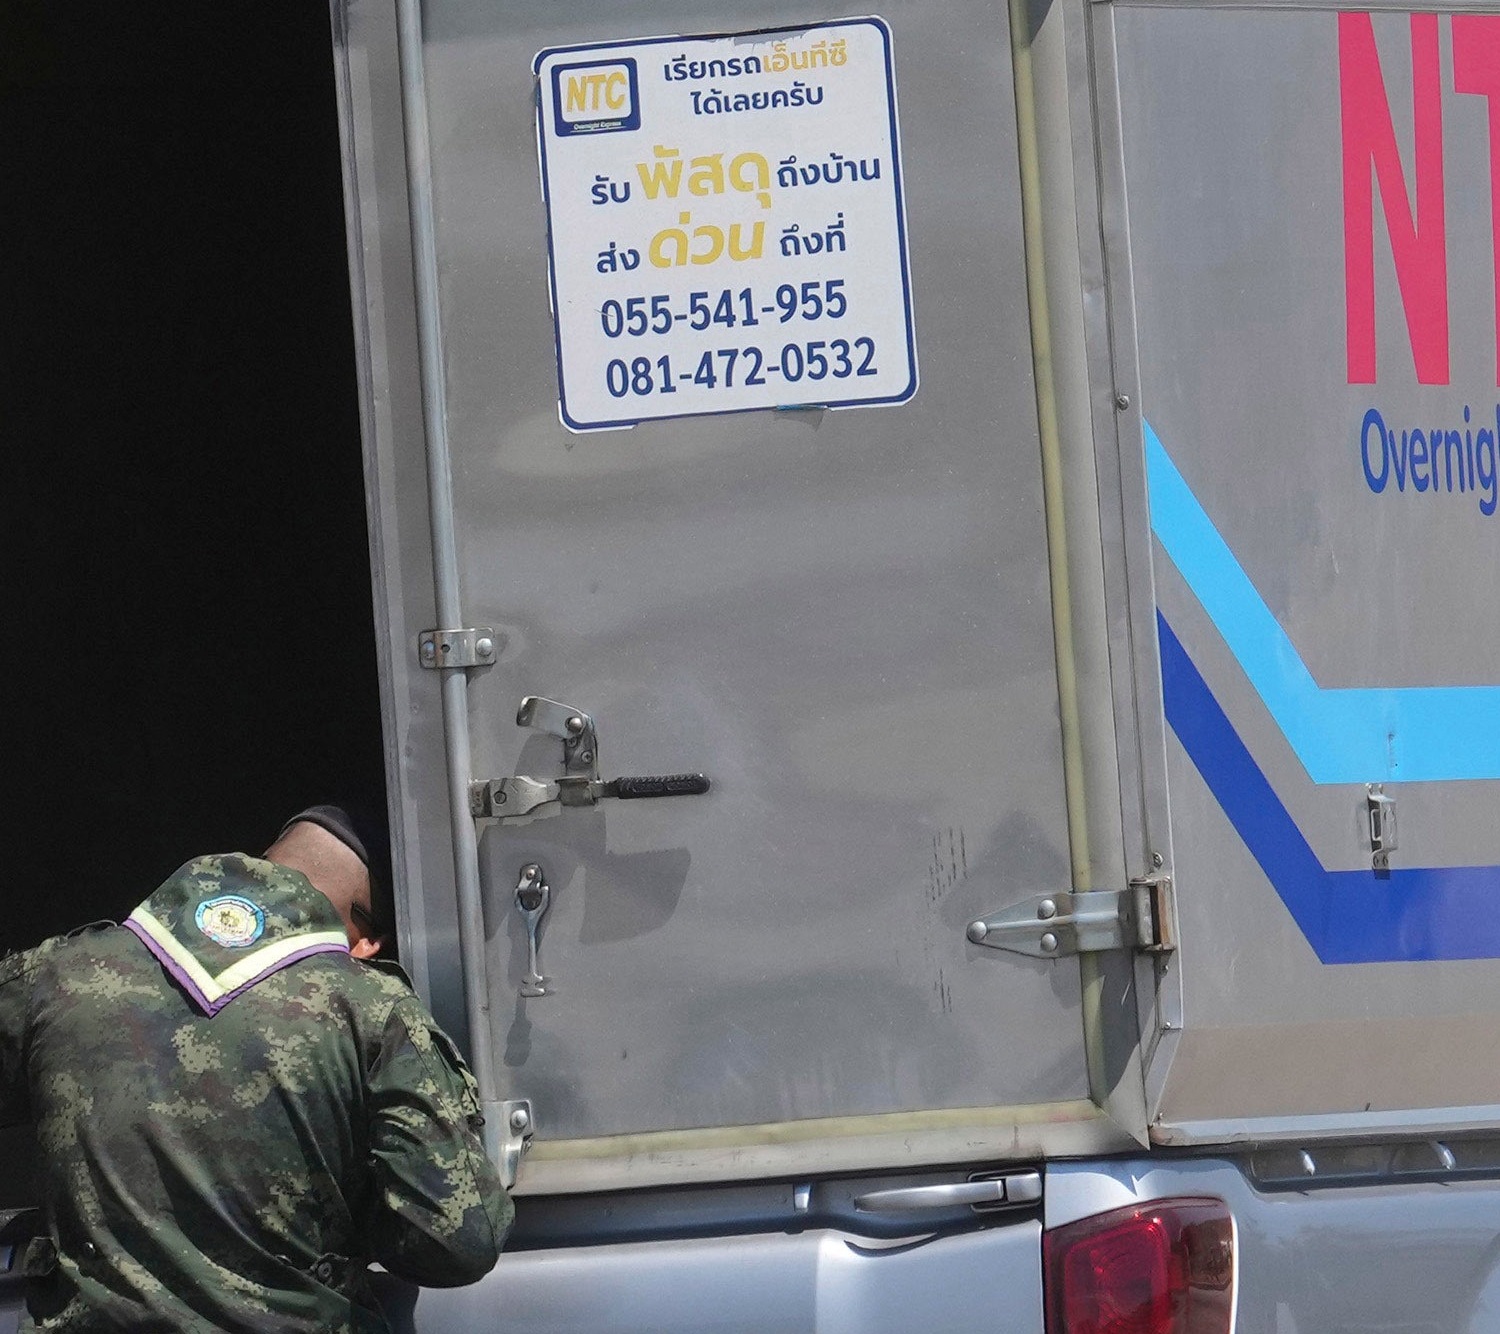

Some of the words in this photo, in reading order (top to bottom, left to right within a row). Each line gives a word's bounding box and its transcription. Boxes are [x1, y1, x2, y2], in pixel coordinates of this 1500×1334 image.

[566, 71, 627, 113] NTC
[691, 80, 824, 116] ได้เลยครับ
[591, 175, 631, 205] รับ
[634, 144, 772, 210] พัสดุ
[776, 152, 881, 188] ถึงบ้าน
[596, 241, 641, 274] ส่ง
[648, 211, 766, 269] ด่วน
[780, 212, 847, 258] ถึงที่
[601, 278, 848, 339] 055-541-955
[606, 336, 878, 398] 081-472-0532
